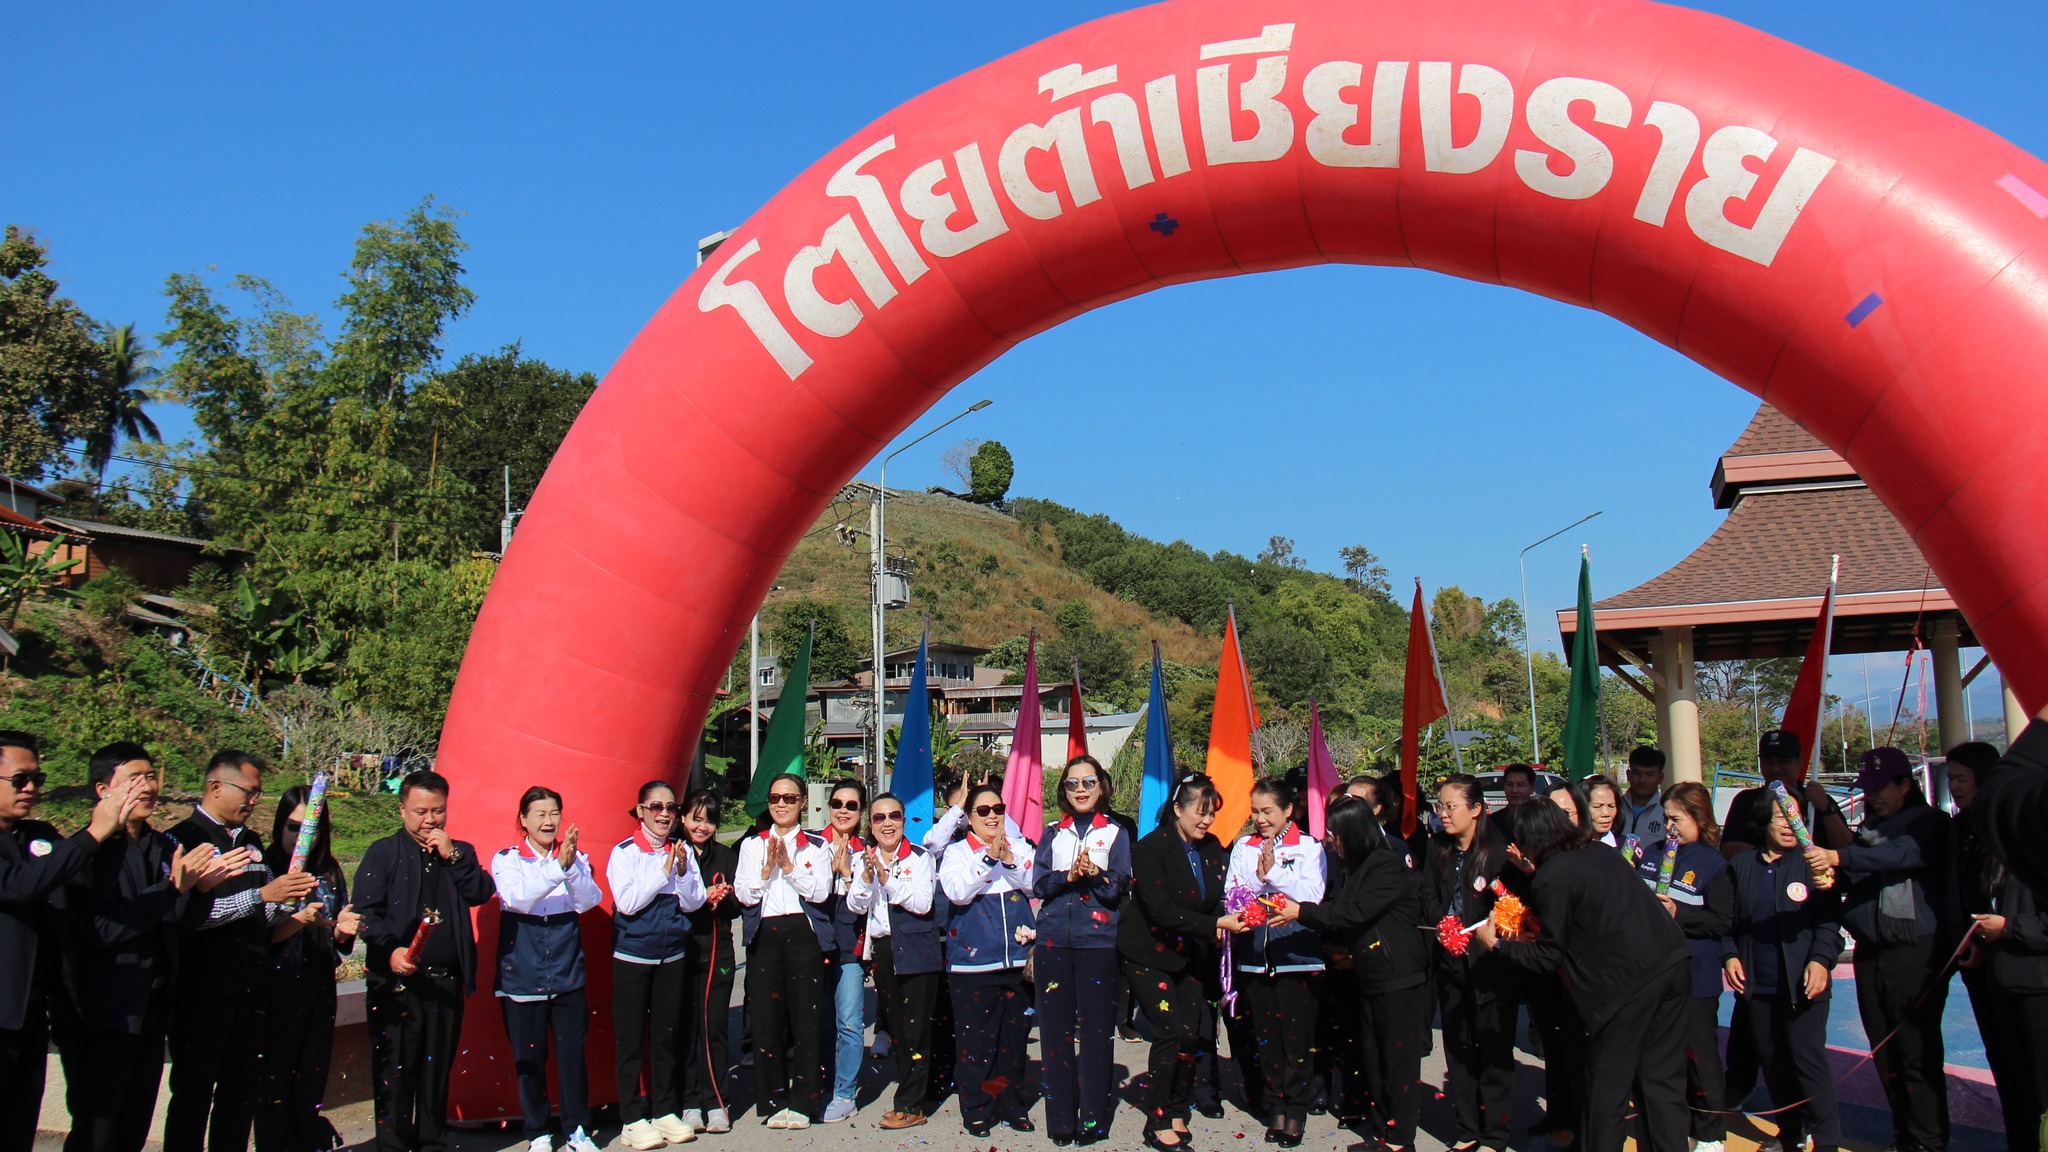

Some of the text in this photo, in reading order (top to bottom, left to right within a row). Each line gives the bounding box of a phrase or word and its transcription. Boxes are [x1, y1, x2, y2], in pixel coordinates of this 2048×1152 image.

[698, 24, 1836, 381] โตโยต้าเชียงราย
